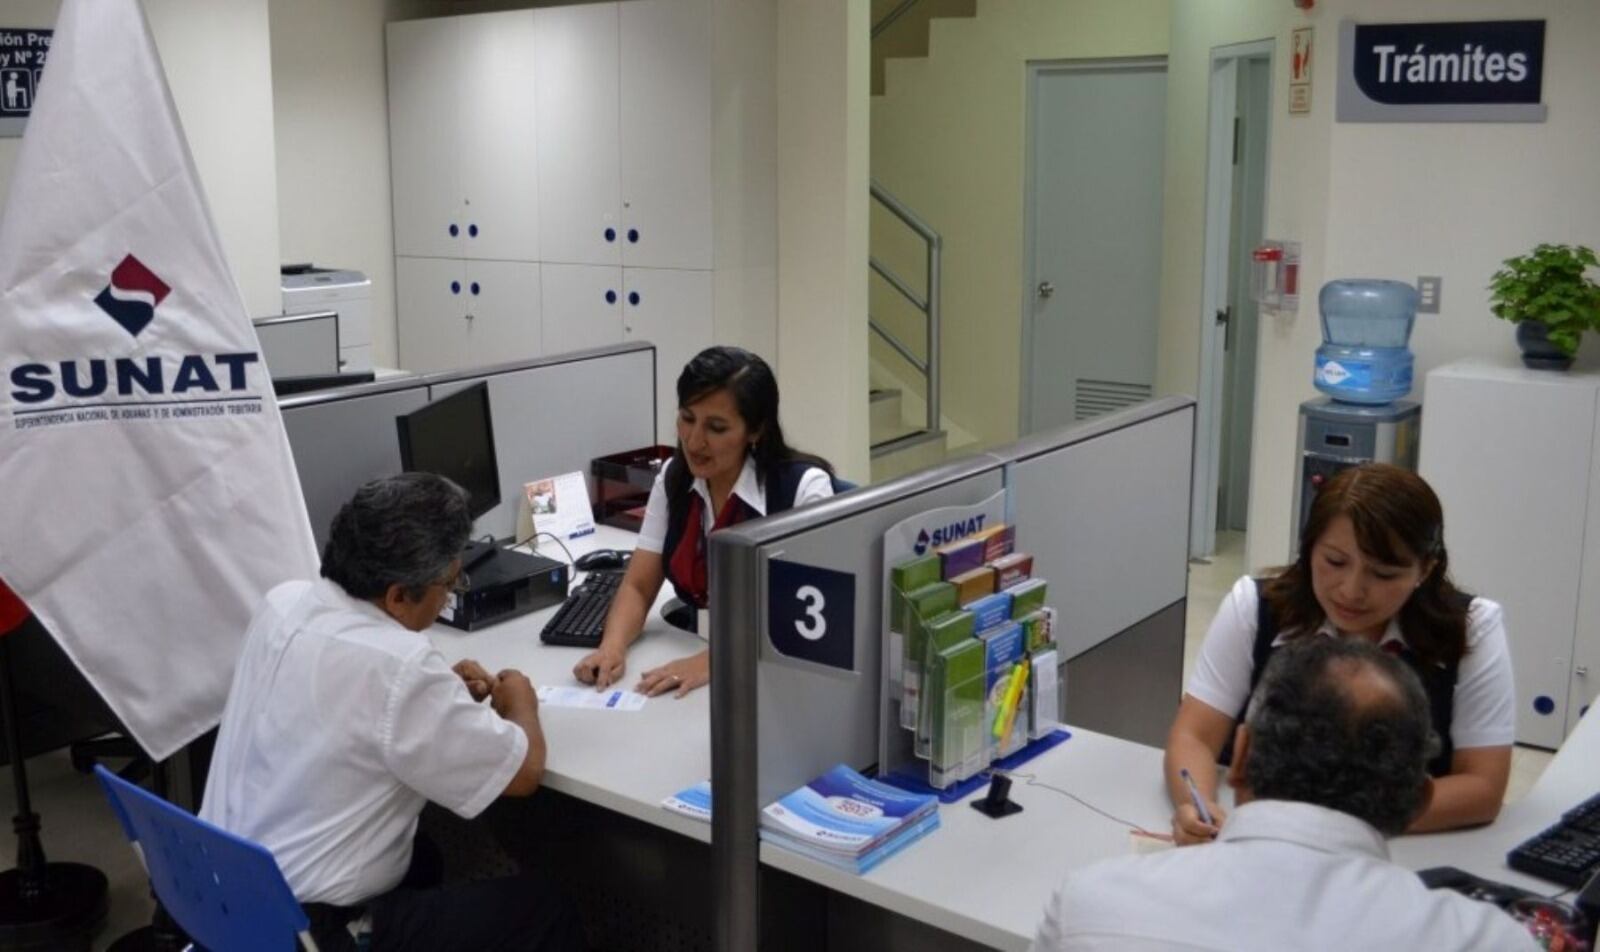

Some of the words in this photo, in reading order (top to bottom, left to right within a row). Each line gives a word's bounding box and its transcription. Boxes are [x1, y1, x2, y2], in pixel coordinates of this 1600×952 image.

[1372, 43, 1528, 83] Trámites
[10, 352, 259, 403] SUNAT
[14, 413, 74, 429] SUPERINTENDENCIA
[76, 410, 107, 422] NACIONAL
[110, 409, 118, 419] DE
[153, 408, 159, 418] Y
[161, 407, 169, 418] DE
[172, 404, 224, 418] ADMINISTRACIÓN
[227, 403, 262, 415] TRIBUTARIA
[932, 513, 986, 547] SUNAT
[794, 585, 827, 641] 3
